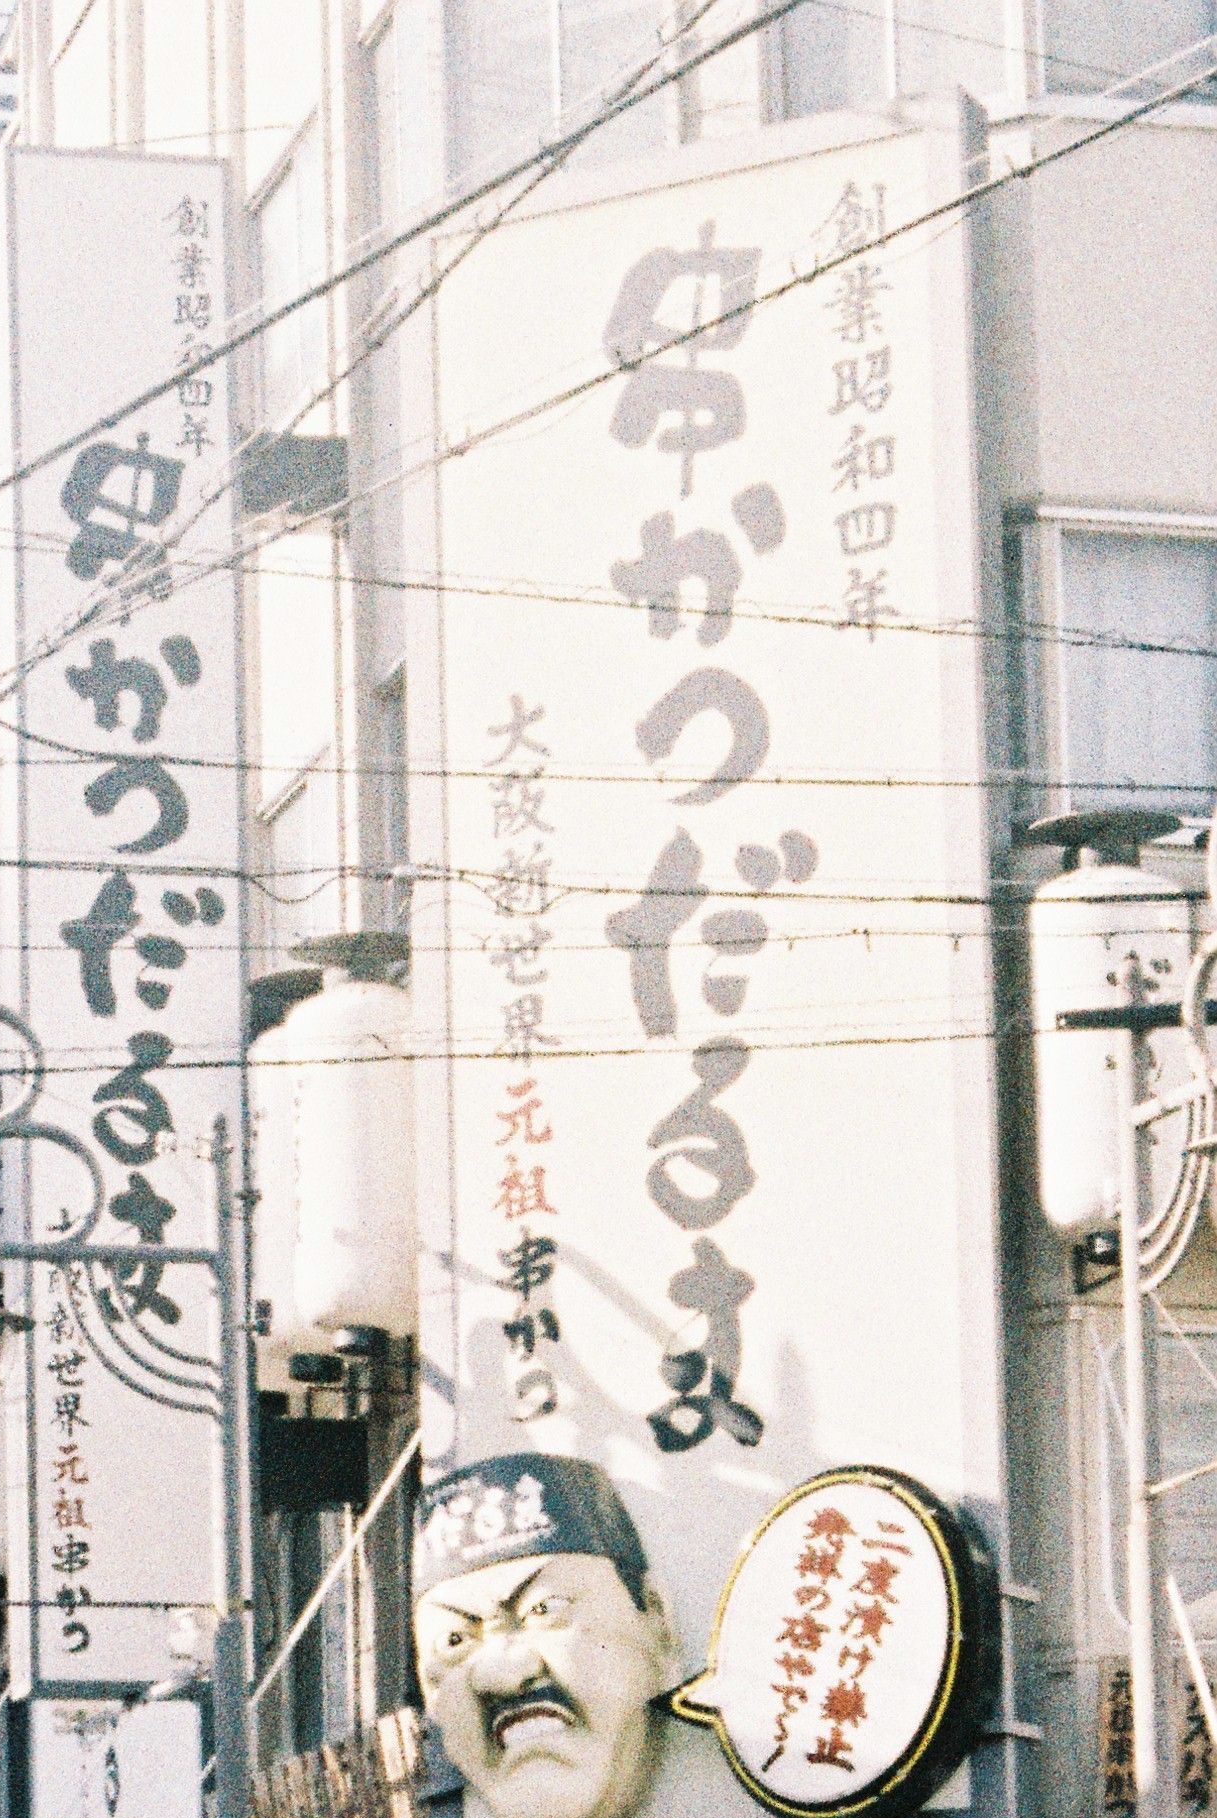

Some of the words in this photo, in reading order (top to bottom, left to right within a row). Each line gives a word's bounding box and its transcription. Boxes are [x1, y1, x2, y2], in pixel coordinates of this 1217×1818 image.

[163, 196, 213, 457] 創業昭和四年
[815, 177, 902, 643] 創業昭和四年
[61, 432, 226, 1326] 串かつだるま
[485, 692, 559, 1424] 大阪新世界元祖串かつ
[601, 218, 820, 1453] 串かつだるま
[806, 1519, 914, 1772] 二度漬け禁止
